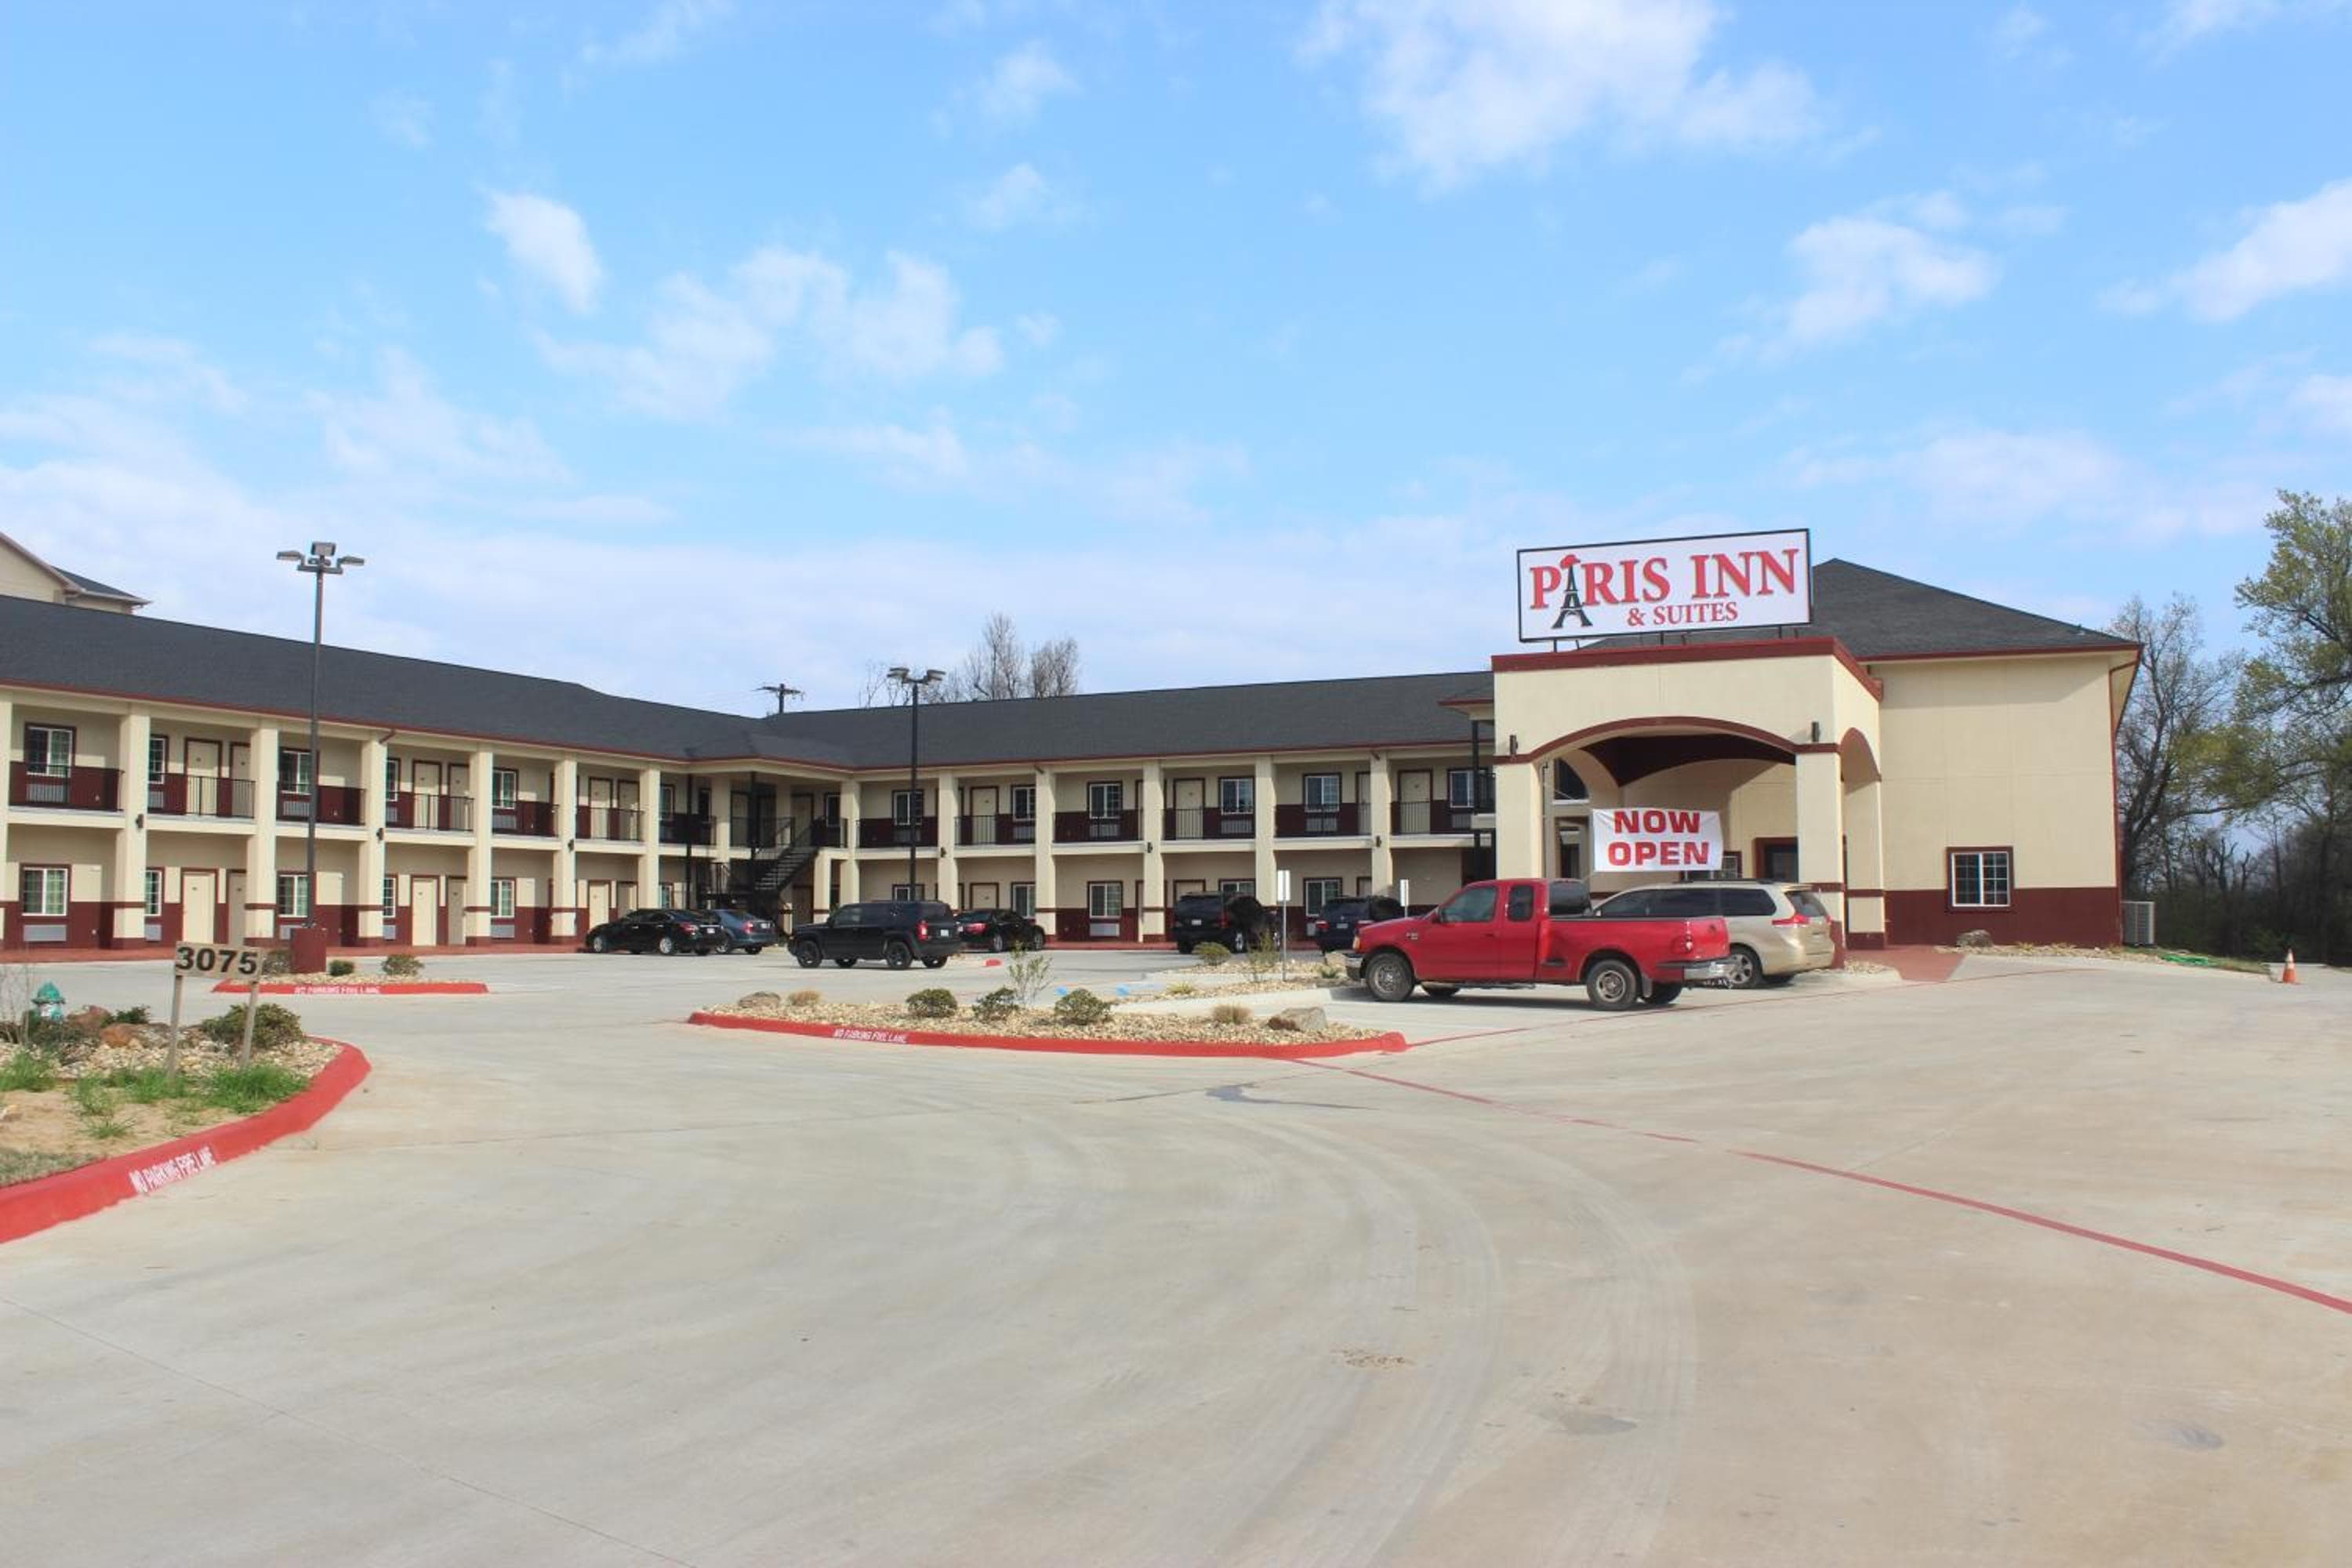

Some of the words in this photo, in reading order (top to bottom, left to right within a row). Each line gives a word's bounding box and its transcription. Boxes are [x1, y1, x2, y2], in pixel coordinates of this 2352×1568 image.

[1530, 554, 1671, 628] PARIS
[1690, 549, 1799, 600] INN
[1628, 607, 1646, 626] &
[1653, 601, 1739, 626] SUITES
[1613, 810, 1700, 834] NOW
[1608, 841, 1709, 866] OPEN
[176, 946, 258, 975] 3075
[844, 1029, 872, 1041] PARKING
[887, 1032, 908, 1044] LANE
[129, 1169, 148, 1193] NO
[142, 1158, 182, 1192] PARKING
[175, 1152, 199, 1179] FIRE
[192, 1146, 216, 1171] LANE
